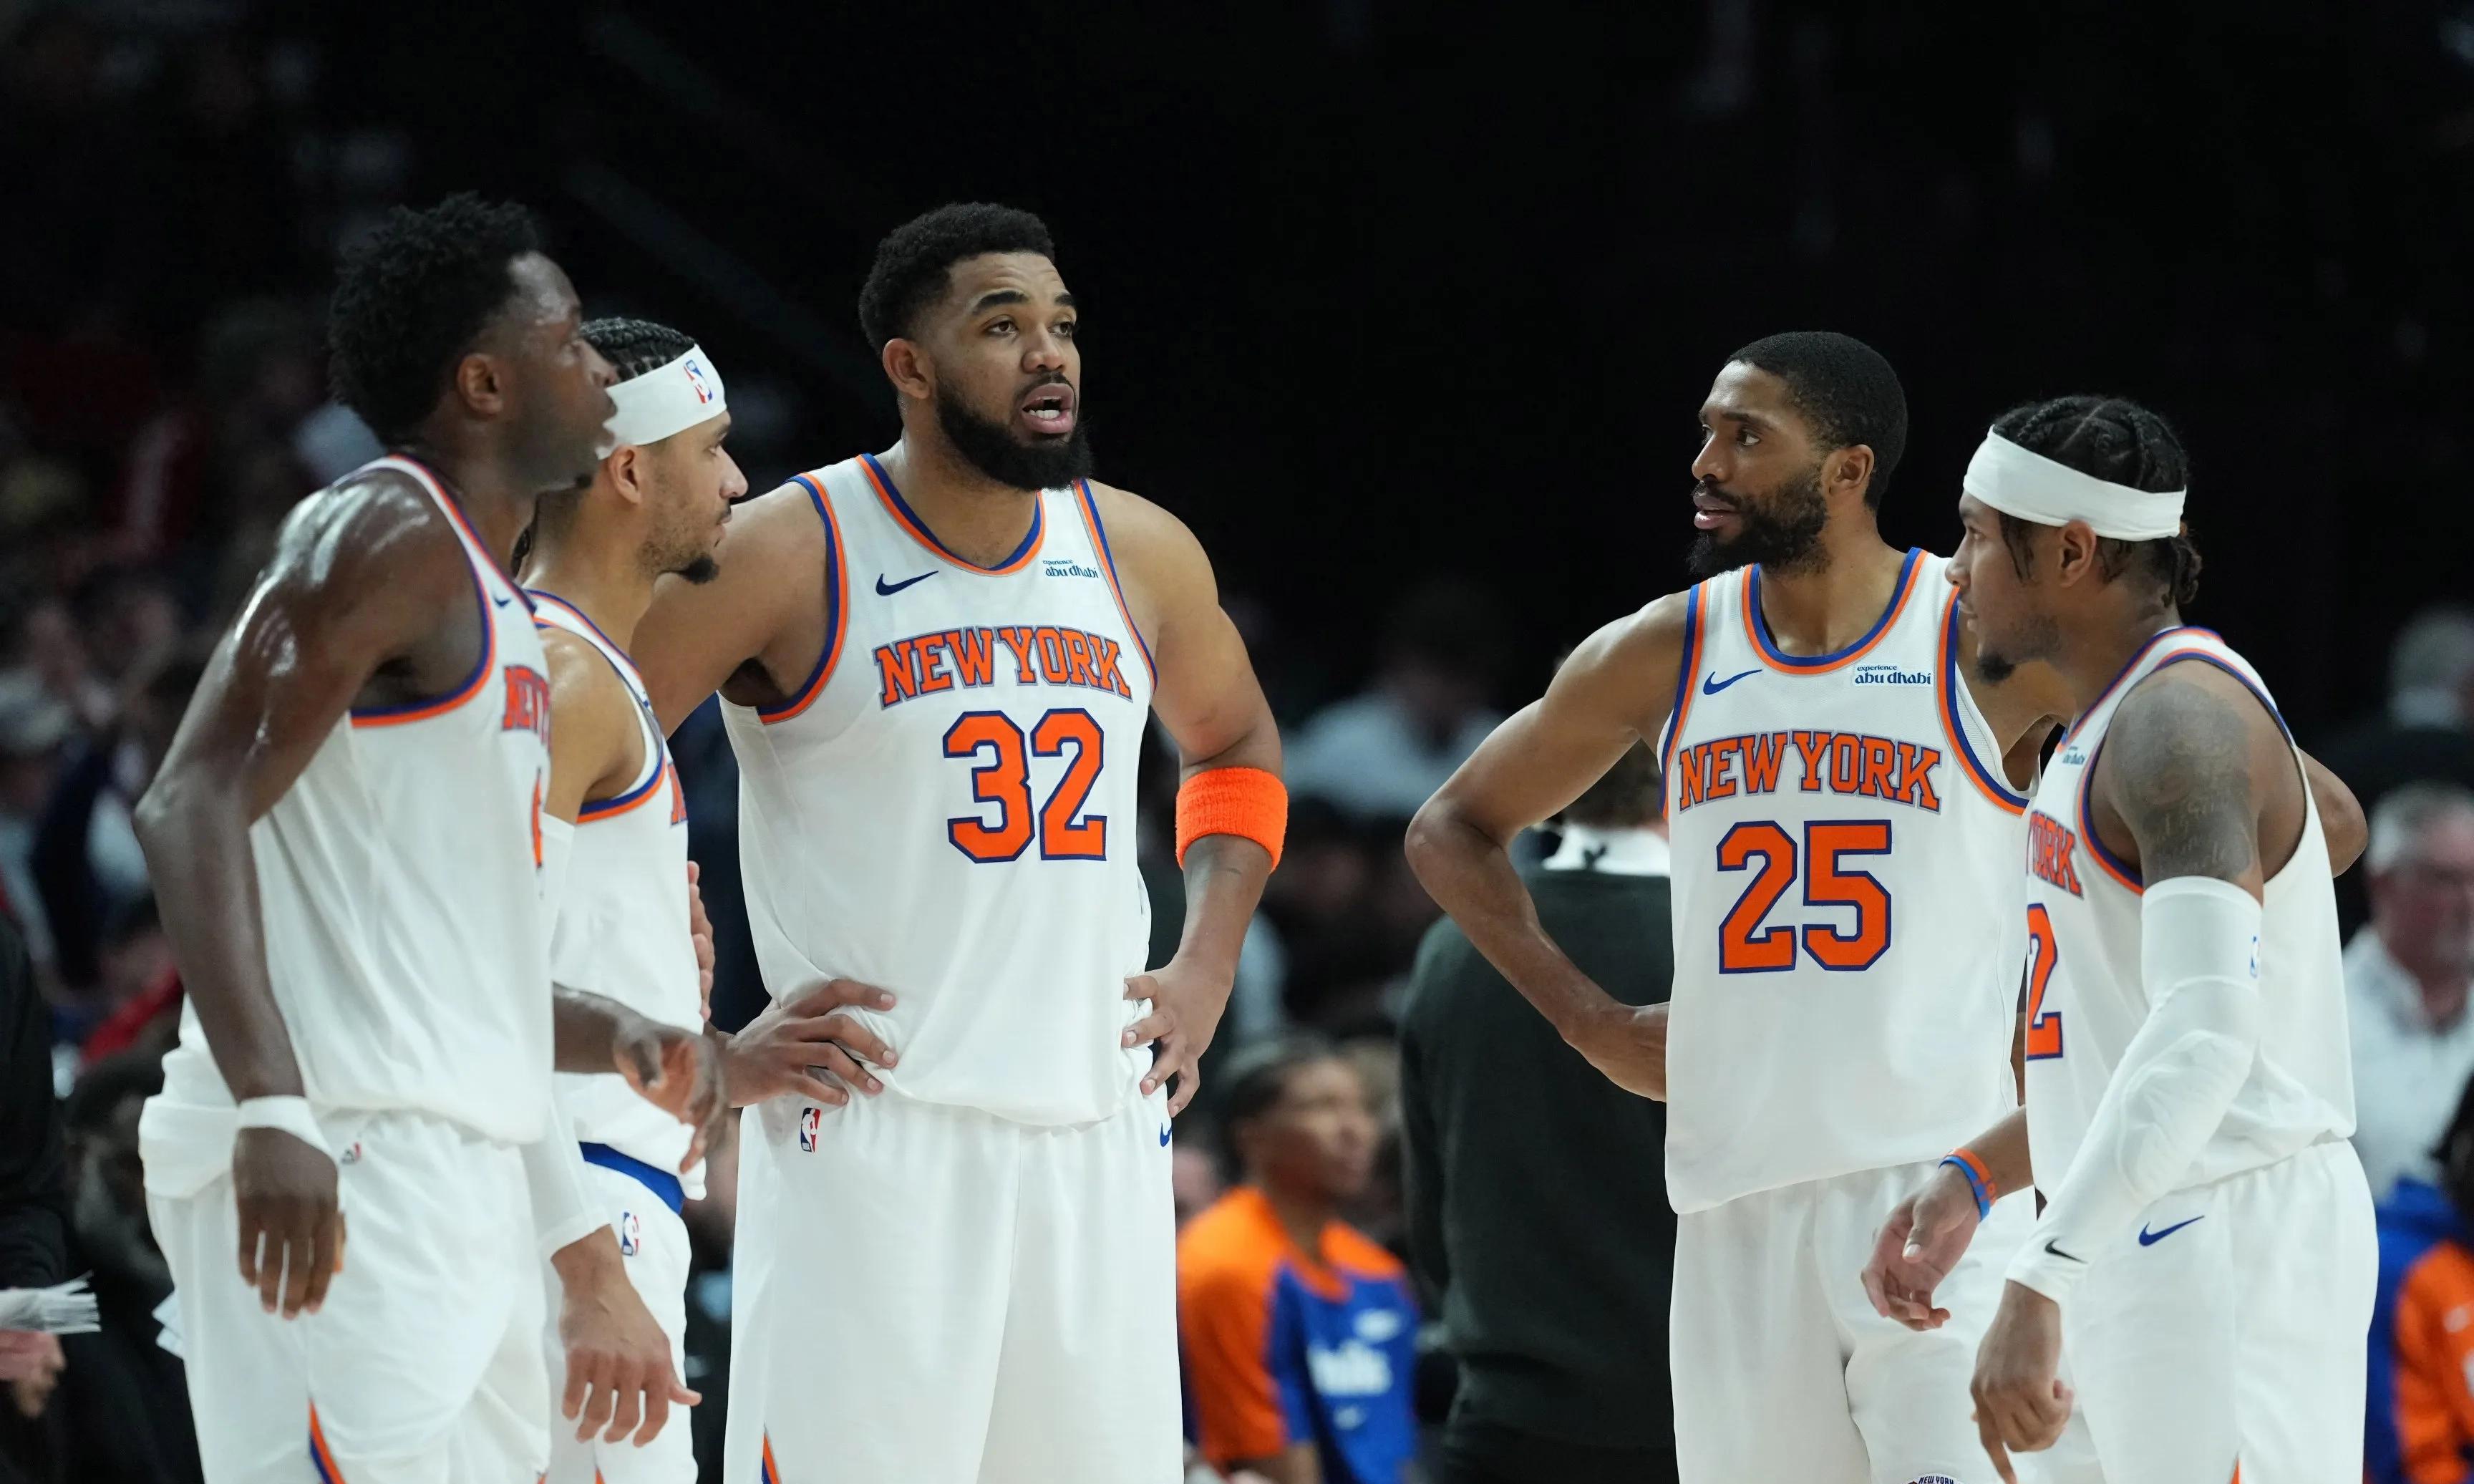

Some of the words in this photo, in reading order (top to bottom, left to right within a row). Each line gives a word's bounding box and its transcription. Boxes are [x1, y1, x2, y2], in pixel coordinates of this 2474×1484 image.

[1045, 566, 1068, 577] abu
[1069, 565, 1099, 578] dhabi
[873, 627, 996, 709] NEW
[994, 626, 1132, 703] YORK
[1855, 672, 1884, 684] abu
[1887, 672, 1931, 684] dhabi
[942, 708, 1107, 864] 32
[1678, 731, 1790, 814] NEW
[1789, 729, 1941, 815] YORK
[1716, 820, 1892, 974] 25
